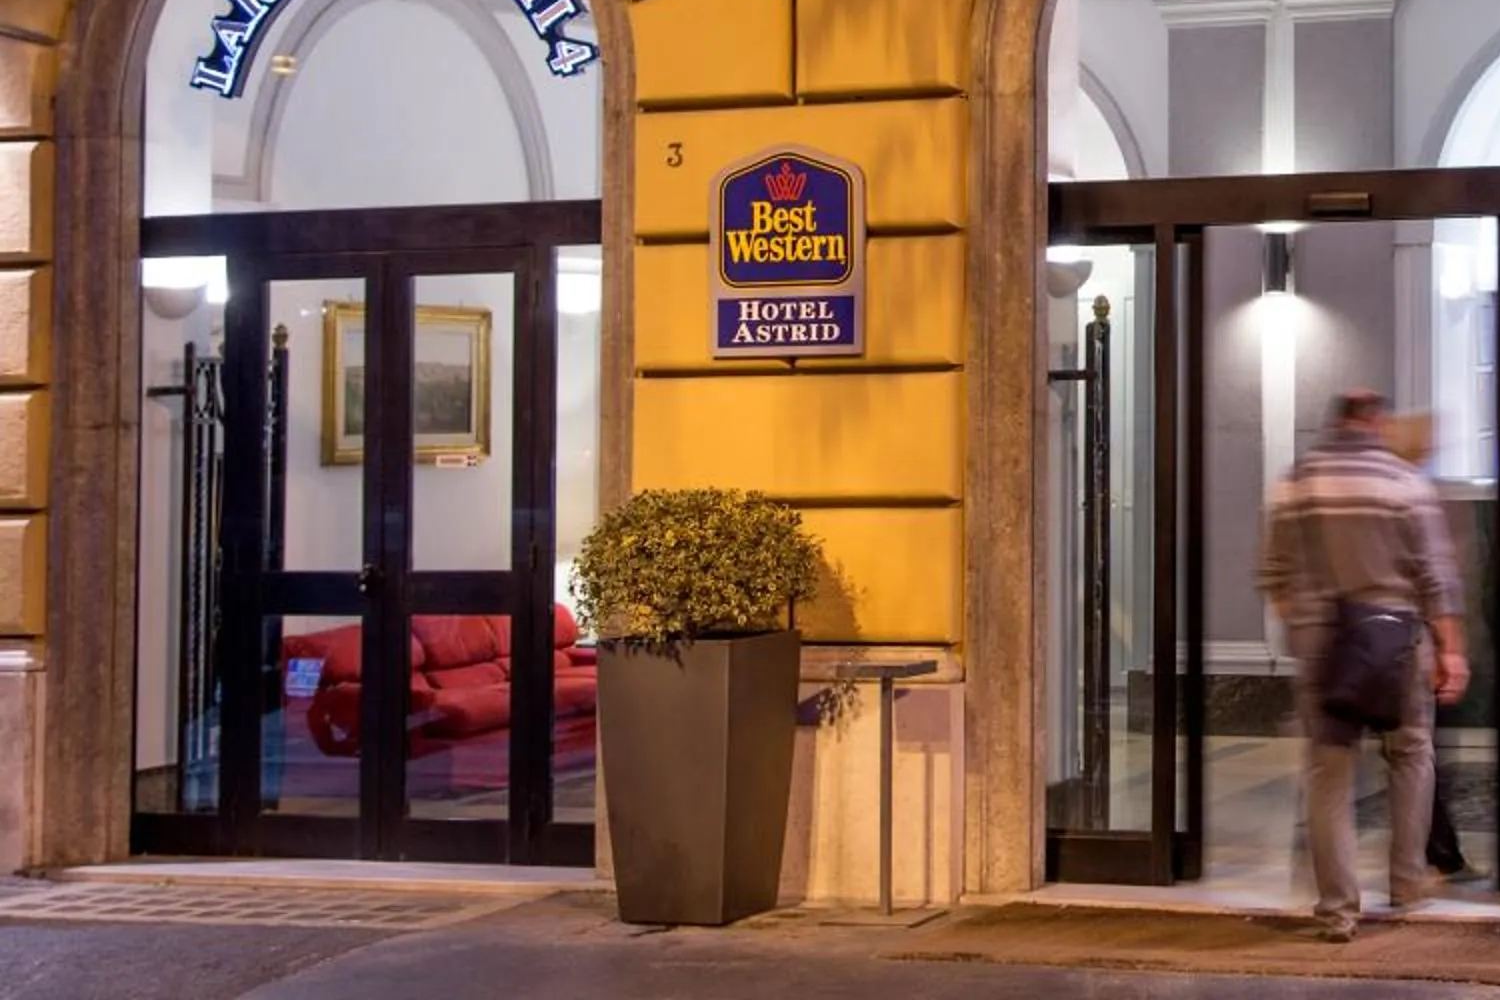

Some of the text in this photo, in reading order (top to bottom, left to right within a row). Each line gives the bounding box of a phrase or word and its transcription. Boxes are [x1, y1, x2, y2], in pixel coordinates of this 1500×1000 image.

[546, 34, 598, 77] 4
[666, 142, 684, 168] 3
[751, 201, 817, 234] Best
[727, 230, 847, 264] Western
[739, 301, 834, 322] HOTEL
[732, 323, 841, 344] ASTRID
